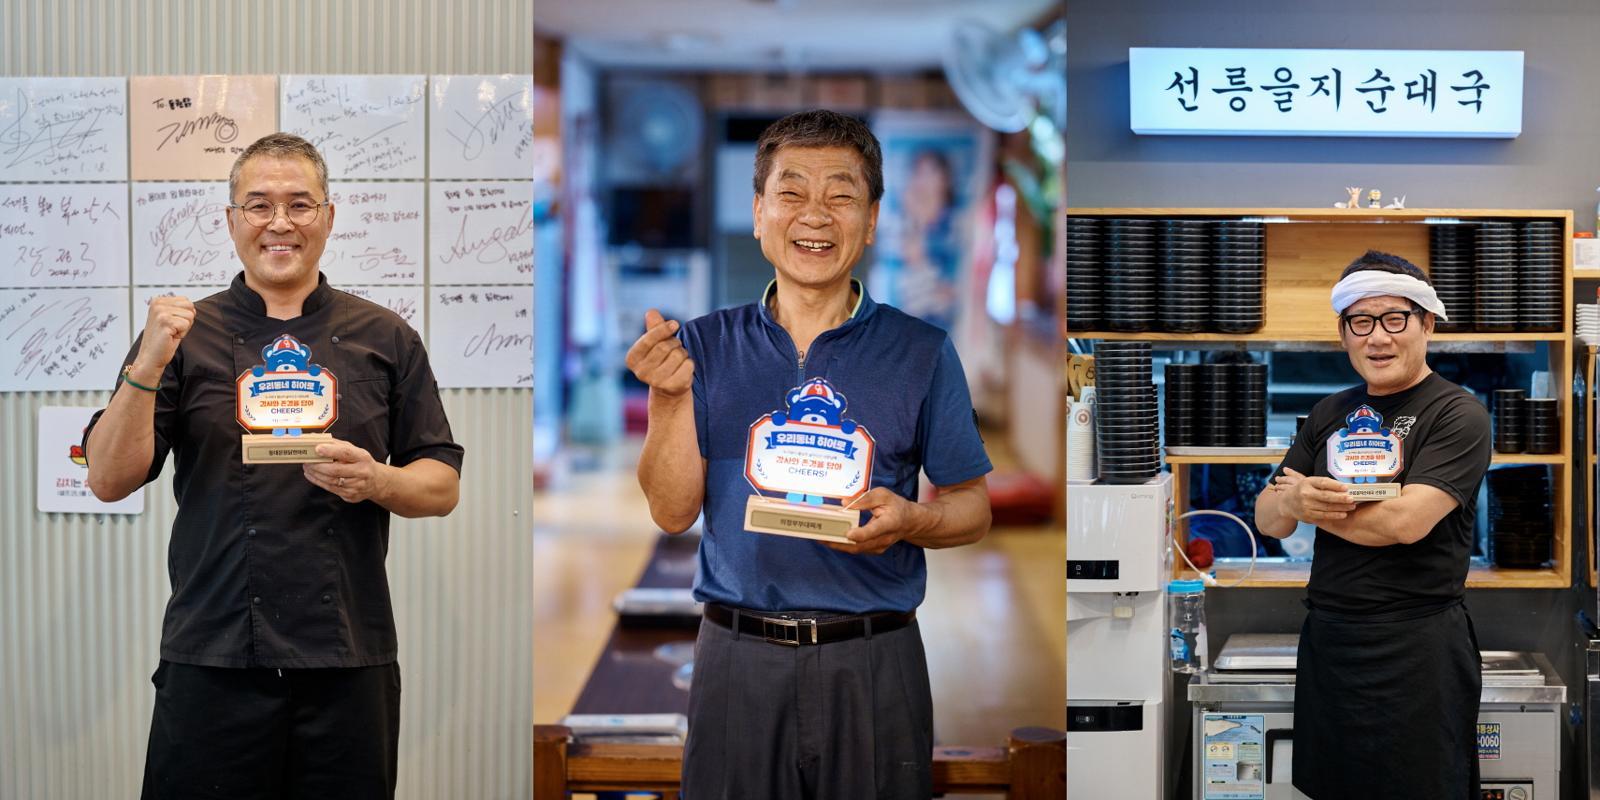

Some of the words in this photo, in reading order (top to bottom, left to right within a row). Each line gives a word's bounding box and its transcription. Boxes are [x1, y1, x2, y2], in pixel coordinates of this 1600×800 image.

[1165, 65, 1492, 114] 선릉을지순대국
[258, 381, 290, 391] 우리동네
[291, 381, 315, 390] 히어로
[776, 433, 816, 445] 우리동네
[817, 436, 847, 452] 히어로
[776, 455, 800, 465] 감사와
[801, 458, 825, 469] 존경을
[788, 466, 828, 478] CHEERS!
[56, 478, 81, 488] 김치는
